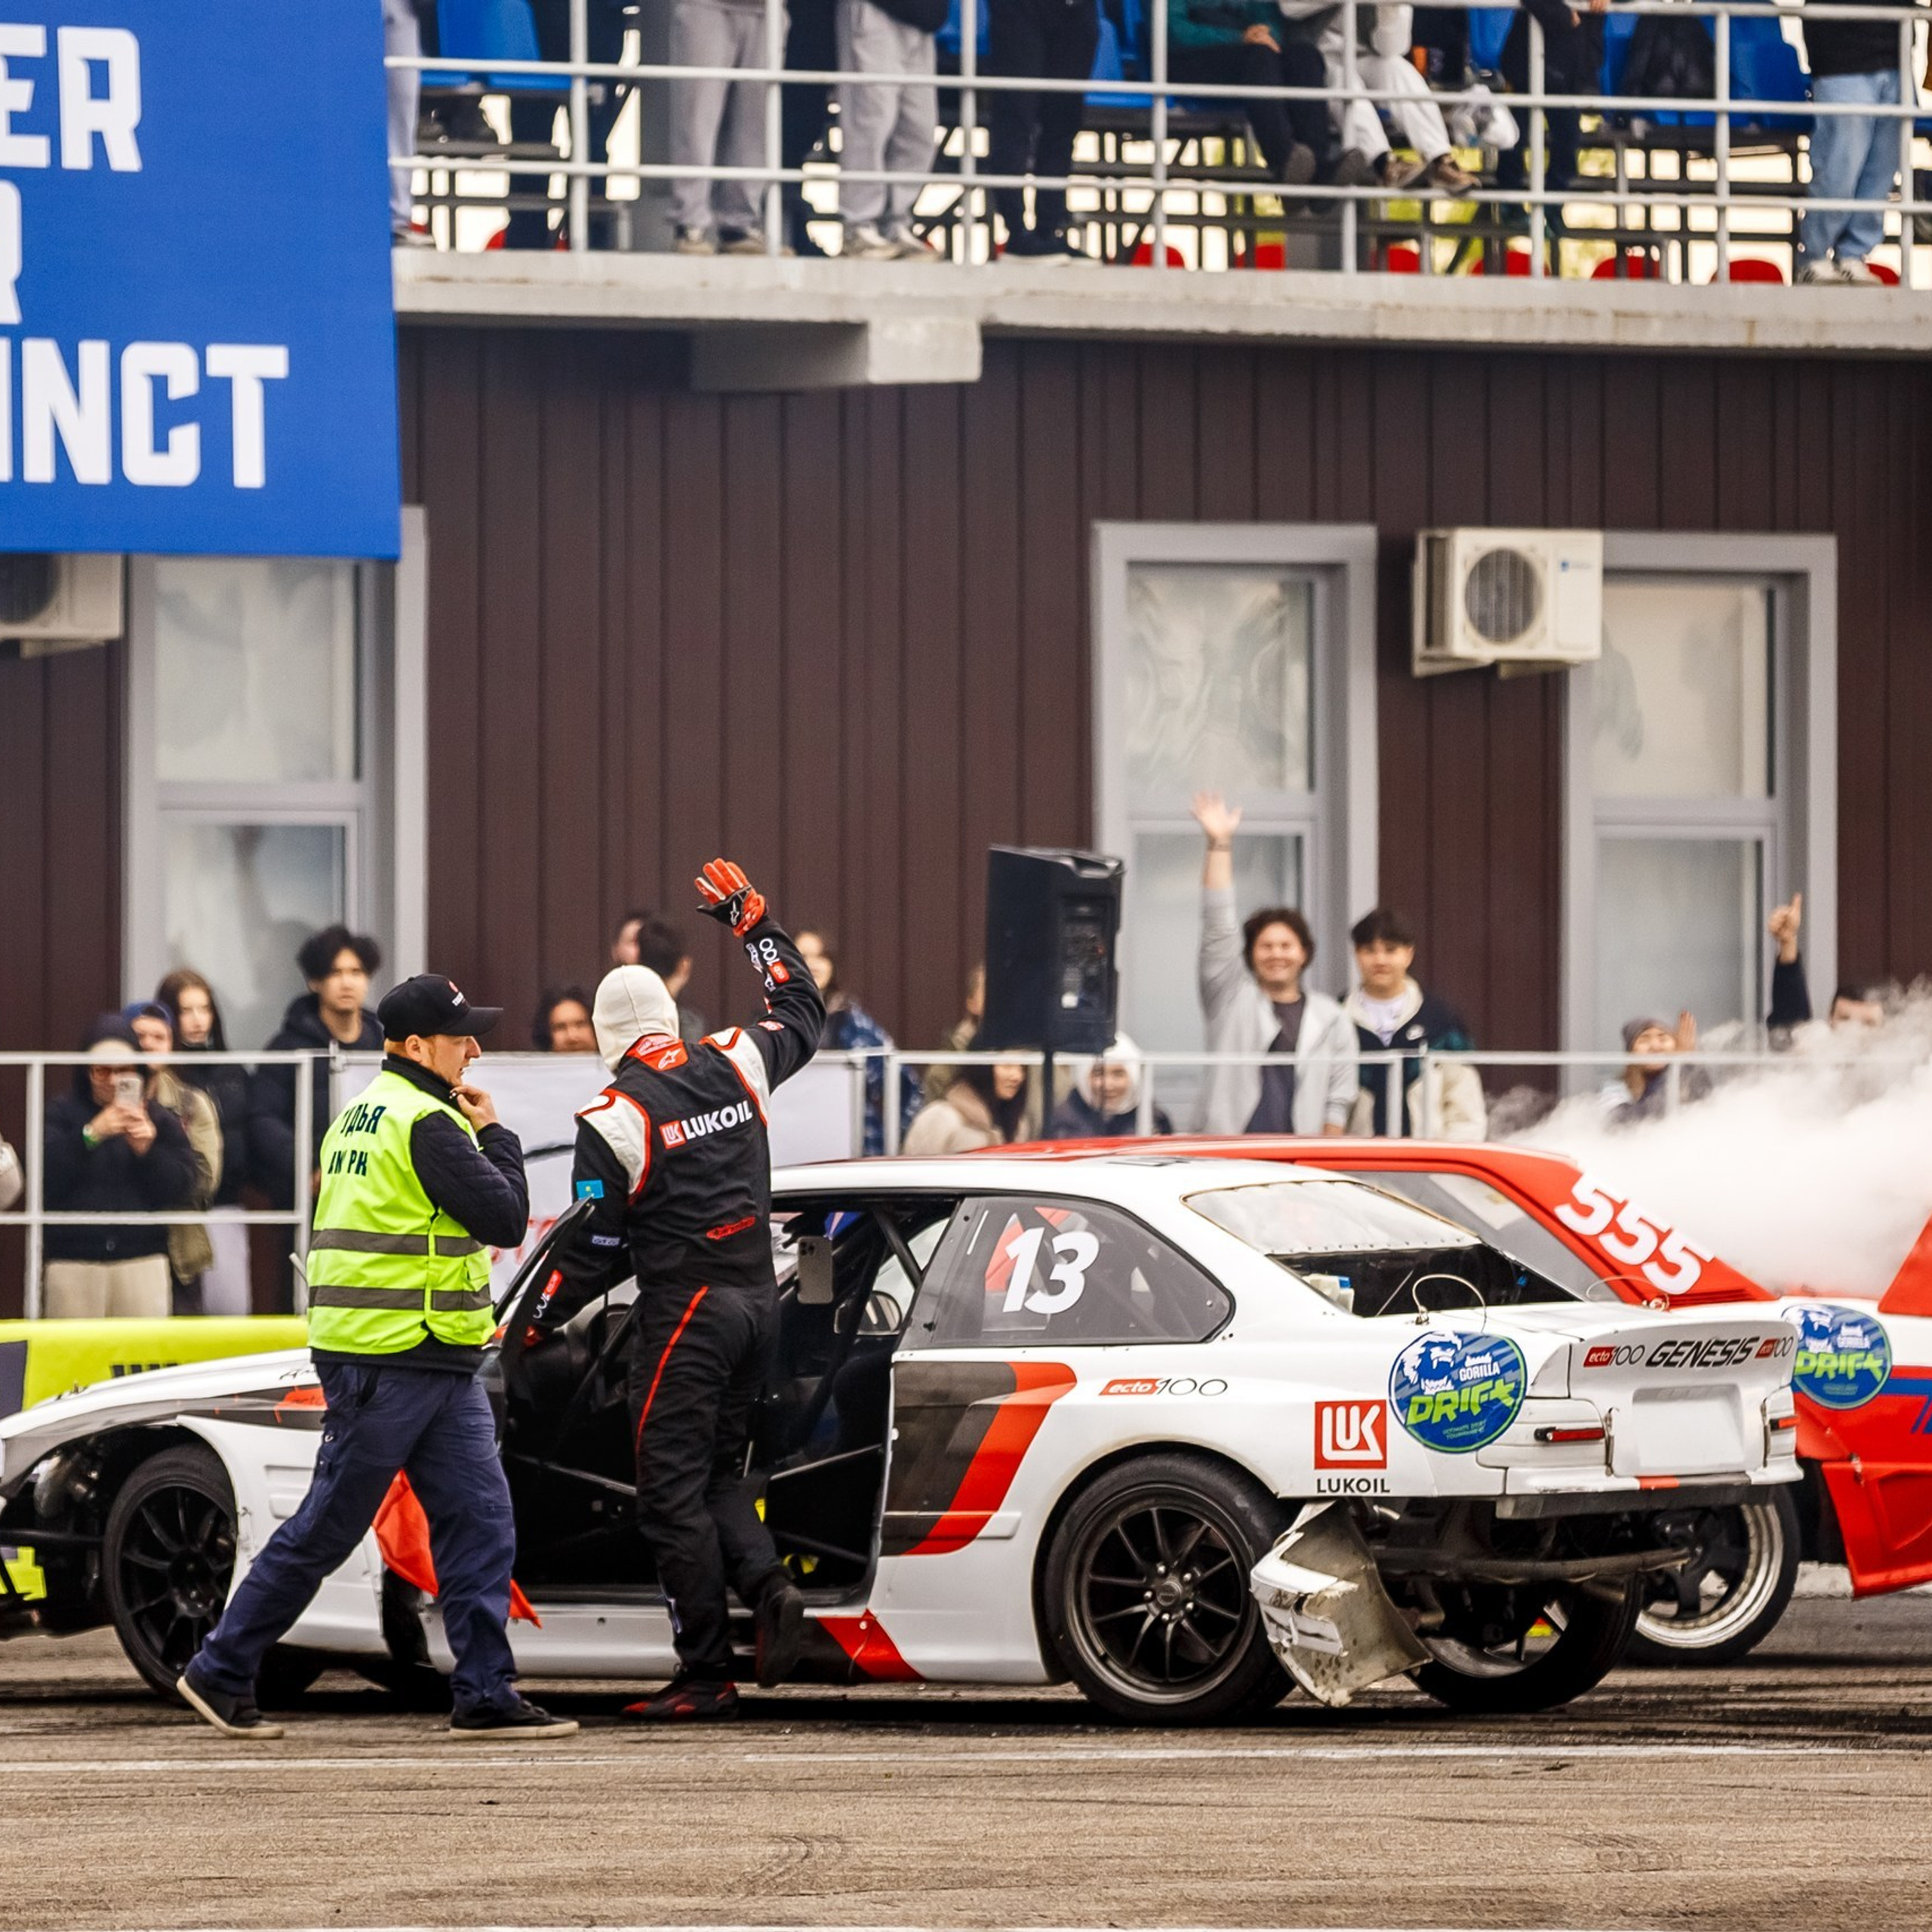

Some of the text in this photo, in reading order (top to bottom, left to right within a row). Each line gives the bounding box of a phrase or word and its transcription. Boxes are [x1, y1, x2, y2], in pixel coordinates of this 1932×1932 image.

[681, 1100, 753, 1140] LUKOIL
[1553, 1171, 1716, 1295] 555
[1002, 1226, 1100, 1315] 13
[1459, 1361, 1501, 1382] GORILLA
[1645, 1337, 1760, 1368] GENESIS
[1794, 1350, 1884, 1383] DRIFT
[1407, 1378, 1515, 1426] DRIFT
[1321, 1404, 1384, 1461] LUK
[1316, 1478, 1391, 1494] LUKOIL
